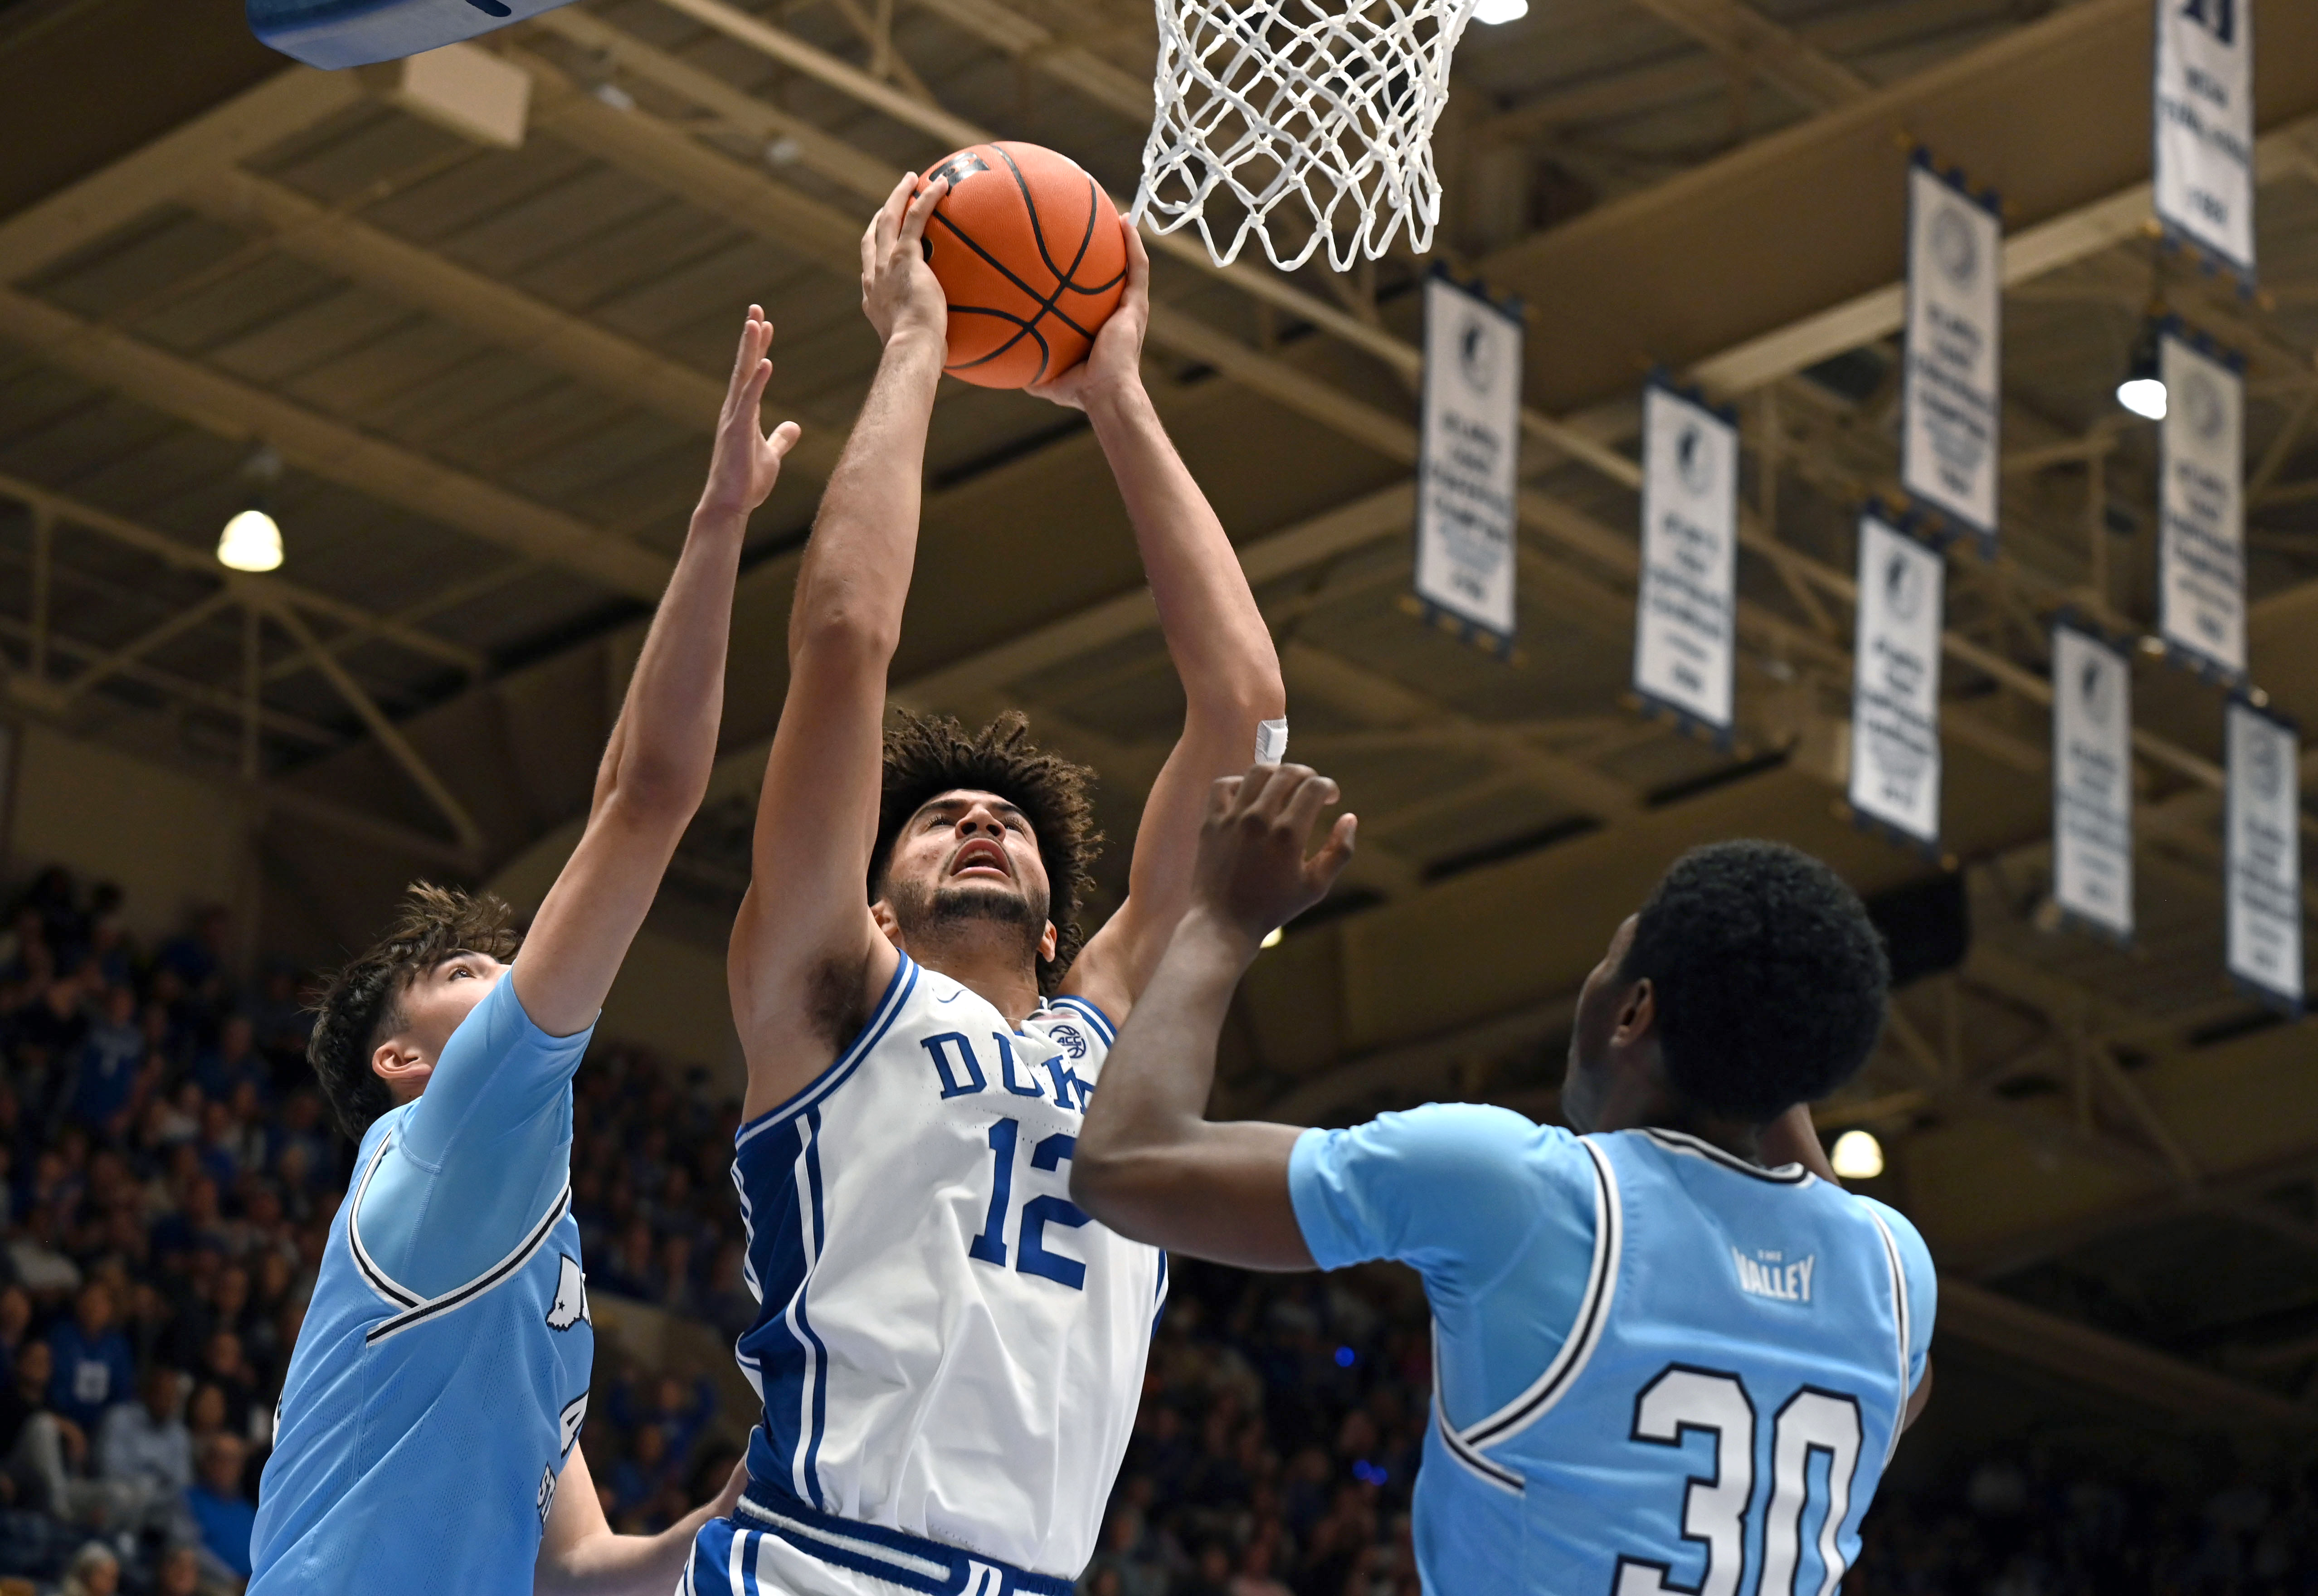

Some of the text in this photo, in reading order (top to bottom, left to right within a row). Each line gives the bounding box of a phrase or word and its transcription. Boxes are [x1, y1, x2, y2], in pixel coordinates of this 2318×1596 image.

[1057, 1036, 1081, 1045] ACC
[969, 1118, 1091, 1290] 12
[1732, 1246, 1814, 1301] VALLEY
[1612, 1362, 1863, 1596] 30
